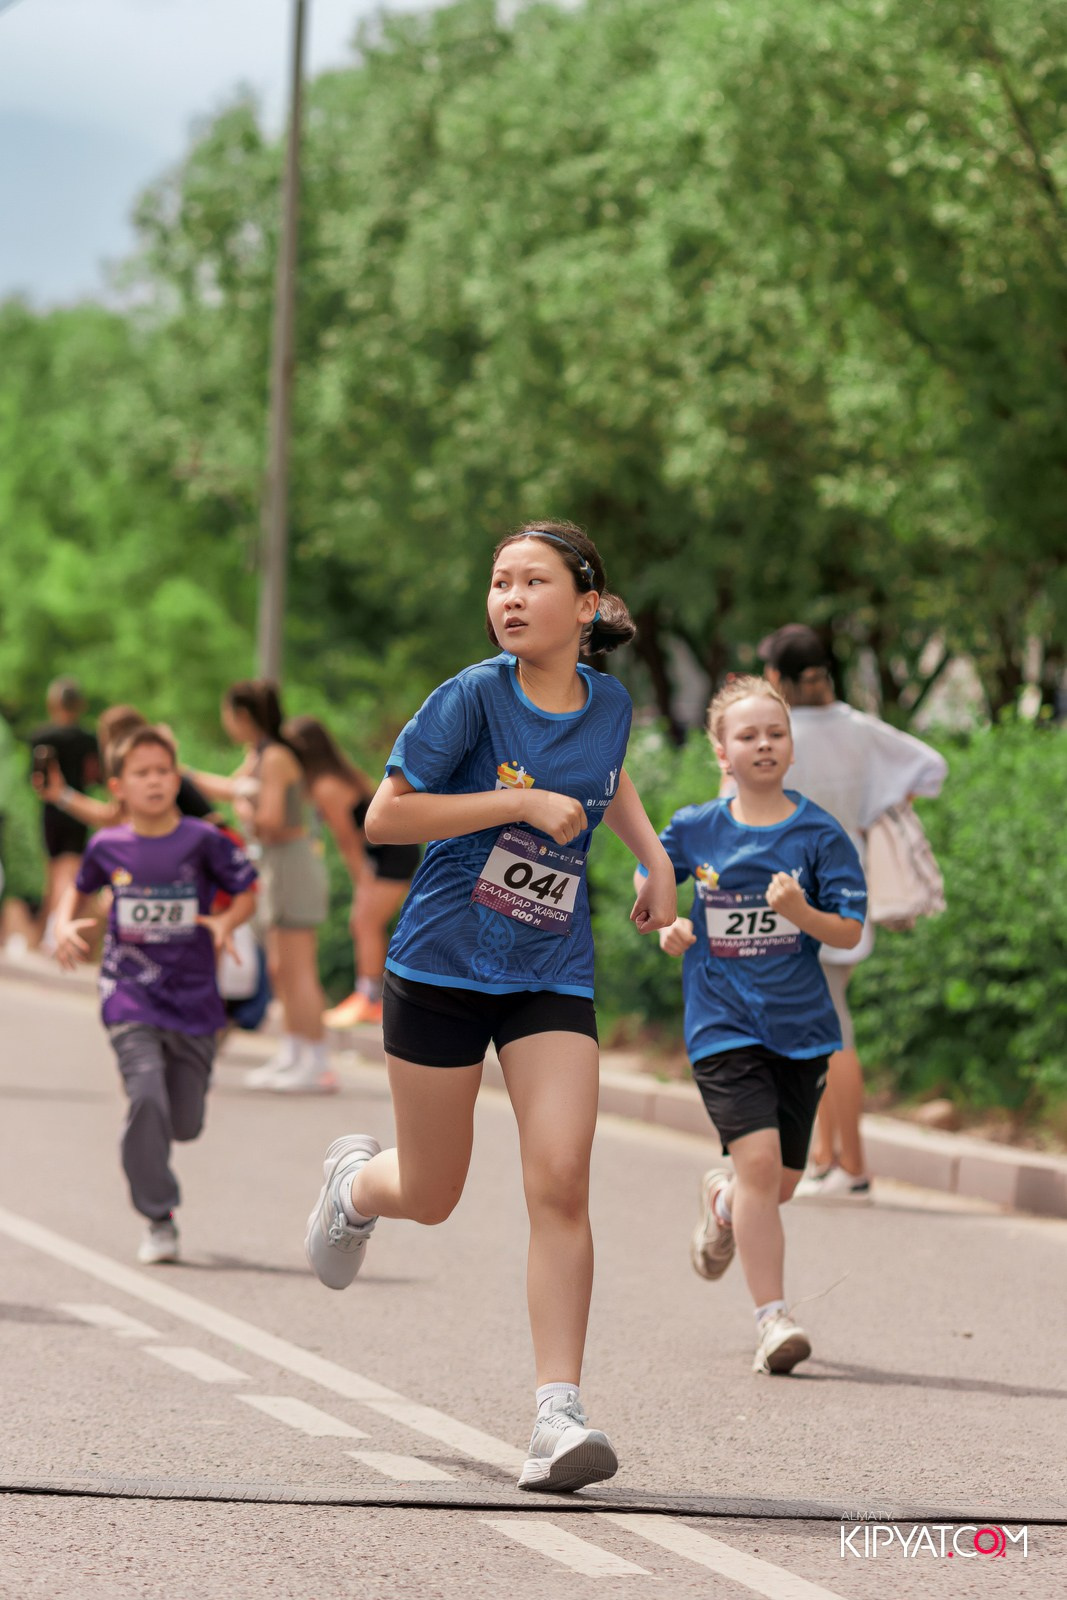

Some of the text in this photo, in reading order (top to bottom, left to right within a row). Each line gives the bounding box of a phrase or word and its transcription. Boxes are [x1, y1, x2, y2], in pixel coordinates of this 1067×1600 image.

[586, 799, 596, 807] BI
[510, 836, 529, 847] GROUP
[503, 862, 570, 905] 044
[478, 882, 569, 922] БАЛАЛАР ЖАРЫСЫ
[131, 902, 184, 923] 028
[511, 908, 534, 922] 600
[725, 911, 777, 935] 215
[753, 936, 797, 946] ЖАРЫСЫ
[738, 947, 758, 957] 600
